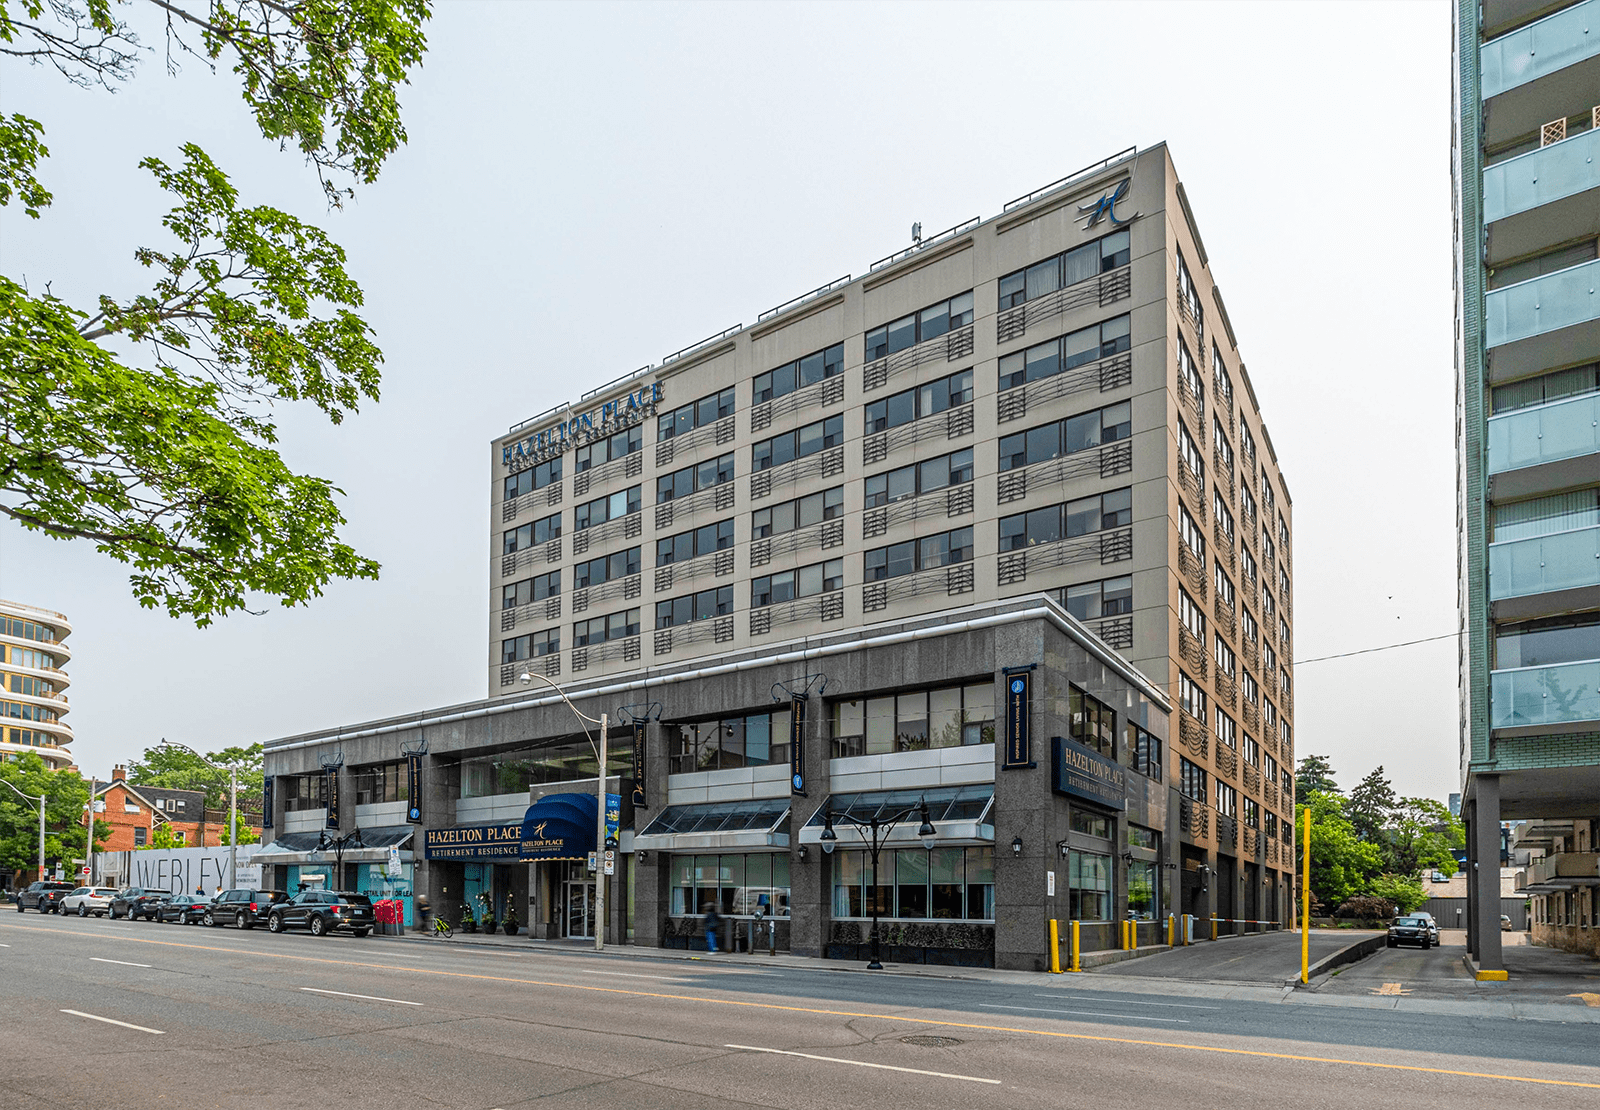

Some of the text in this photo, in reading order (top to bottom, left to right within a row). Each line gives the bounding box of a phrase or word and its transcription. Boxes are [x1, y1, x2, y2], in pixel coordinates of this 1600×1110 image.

[502, 380, 665, 466] HAZELTON PLACE
[1065, 747, 1123, 786] HAZELTON PLACE
[1068, 776, 1098, 794] RETIREMENT
[428, 826, 522, 843] HAZELTON PLACE
[432, 846, 518, 857] RETIREMENT RESIDENCE
[137, 858, 228, 895] WEBLEY
